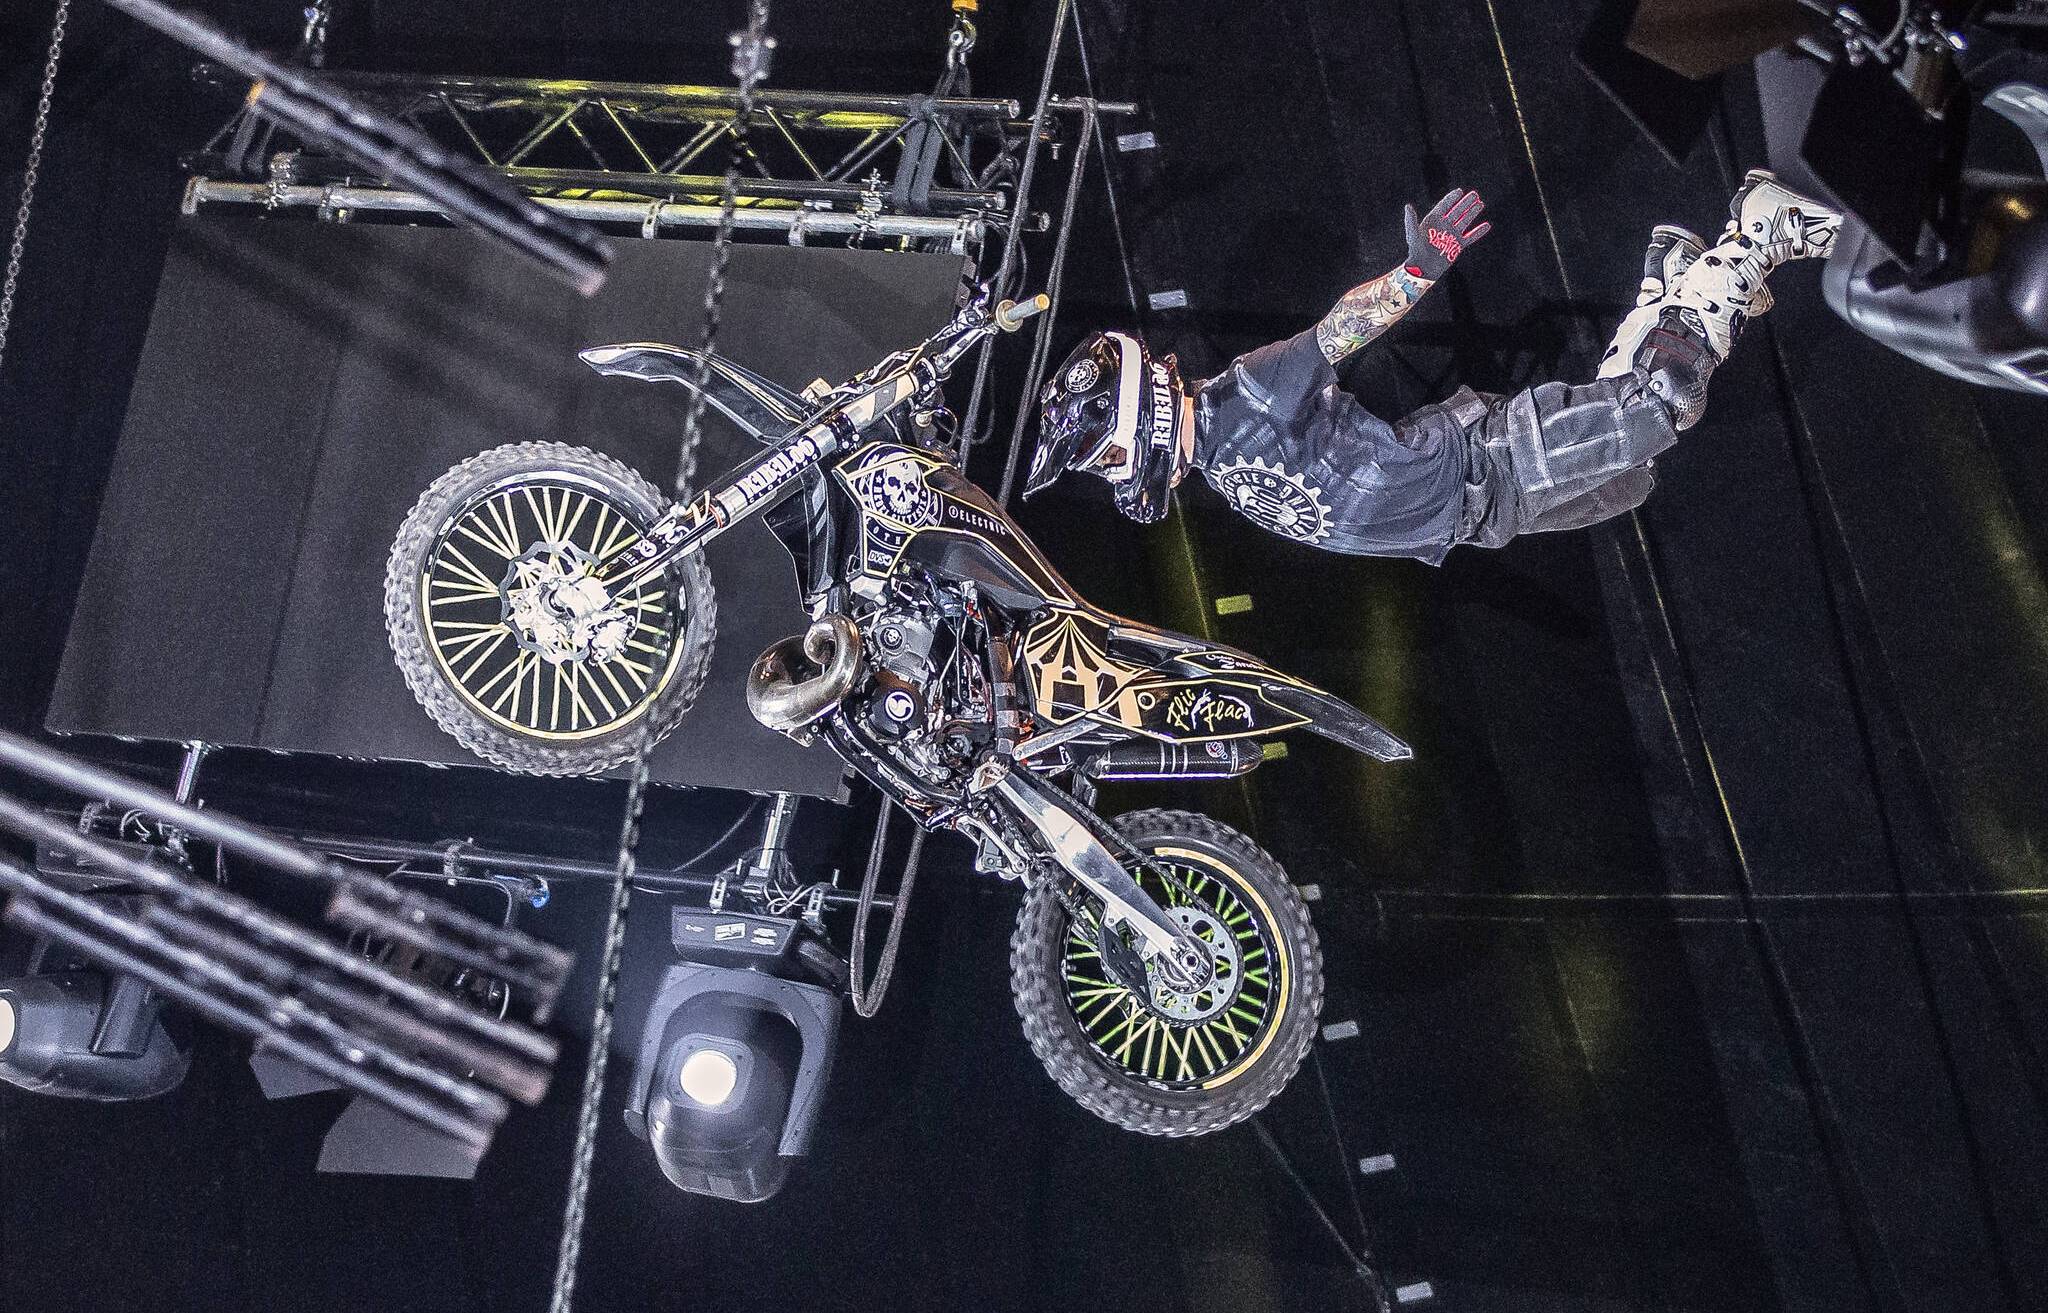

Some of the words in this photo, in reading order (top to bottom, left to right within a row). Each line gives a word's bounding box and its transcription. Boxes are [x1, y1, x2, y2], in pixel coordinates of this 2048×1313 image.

[748, 454, 818, 504] CLOTHING
[959, 509, 1006, 536] ELECTRIC
[869, 551, 885, 563] DVS
[1166, 688, 1196, 732] Flic
[1199, 700, 1244, 732] Flac
